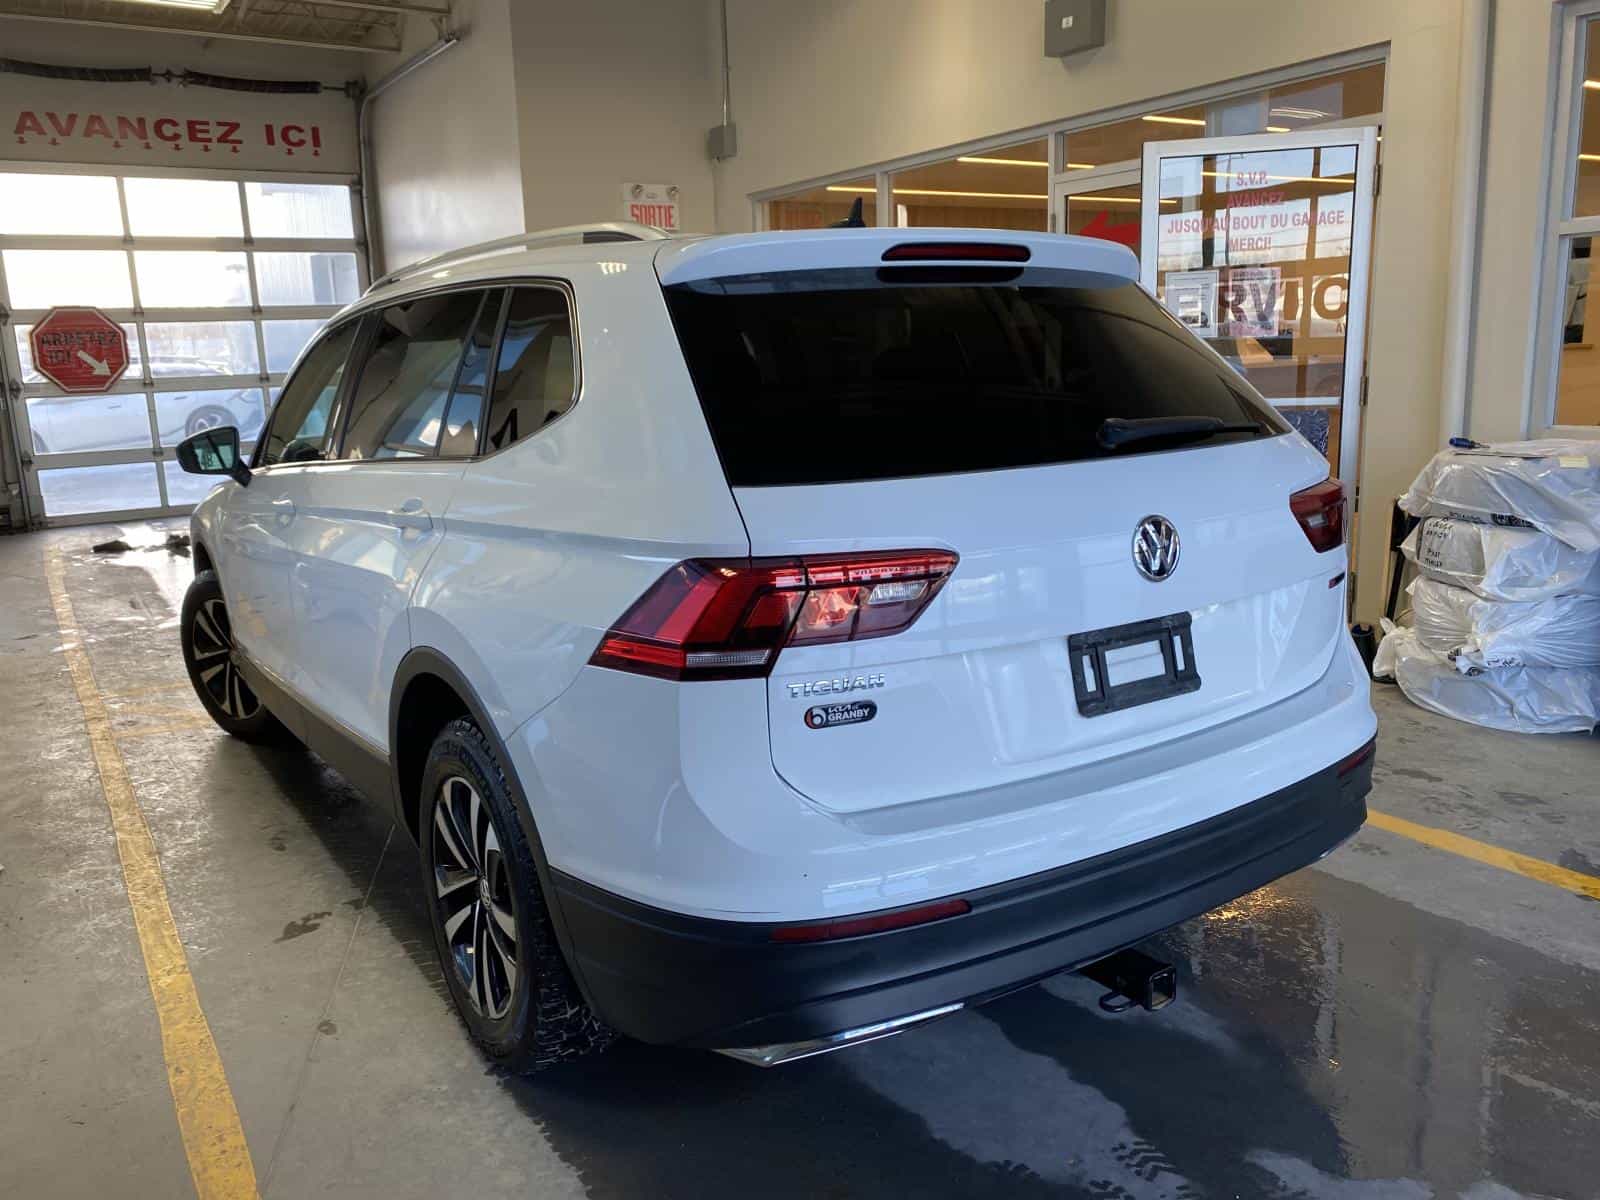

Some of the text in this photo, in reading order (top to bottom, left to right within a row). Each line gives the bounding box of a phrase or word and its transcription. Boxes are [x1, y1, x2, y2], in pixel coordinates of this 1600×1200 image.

[14, 110, 243, 145] AVANCEZ
[1236, 171, 1268, 187] S.V.P.
[1226, 191, 1286, 209] AVANCEZ
[630, 203, 674, 228] SORTIE
[1233, 215, 1266, 231] BOUT
[1271, 213, 1288, 229] DU
[1292, 210, 1345, 226] GARAGE
[787, 673, 886, 698] TIGUAN
[828, 707, 870, 721] GRANBY
